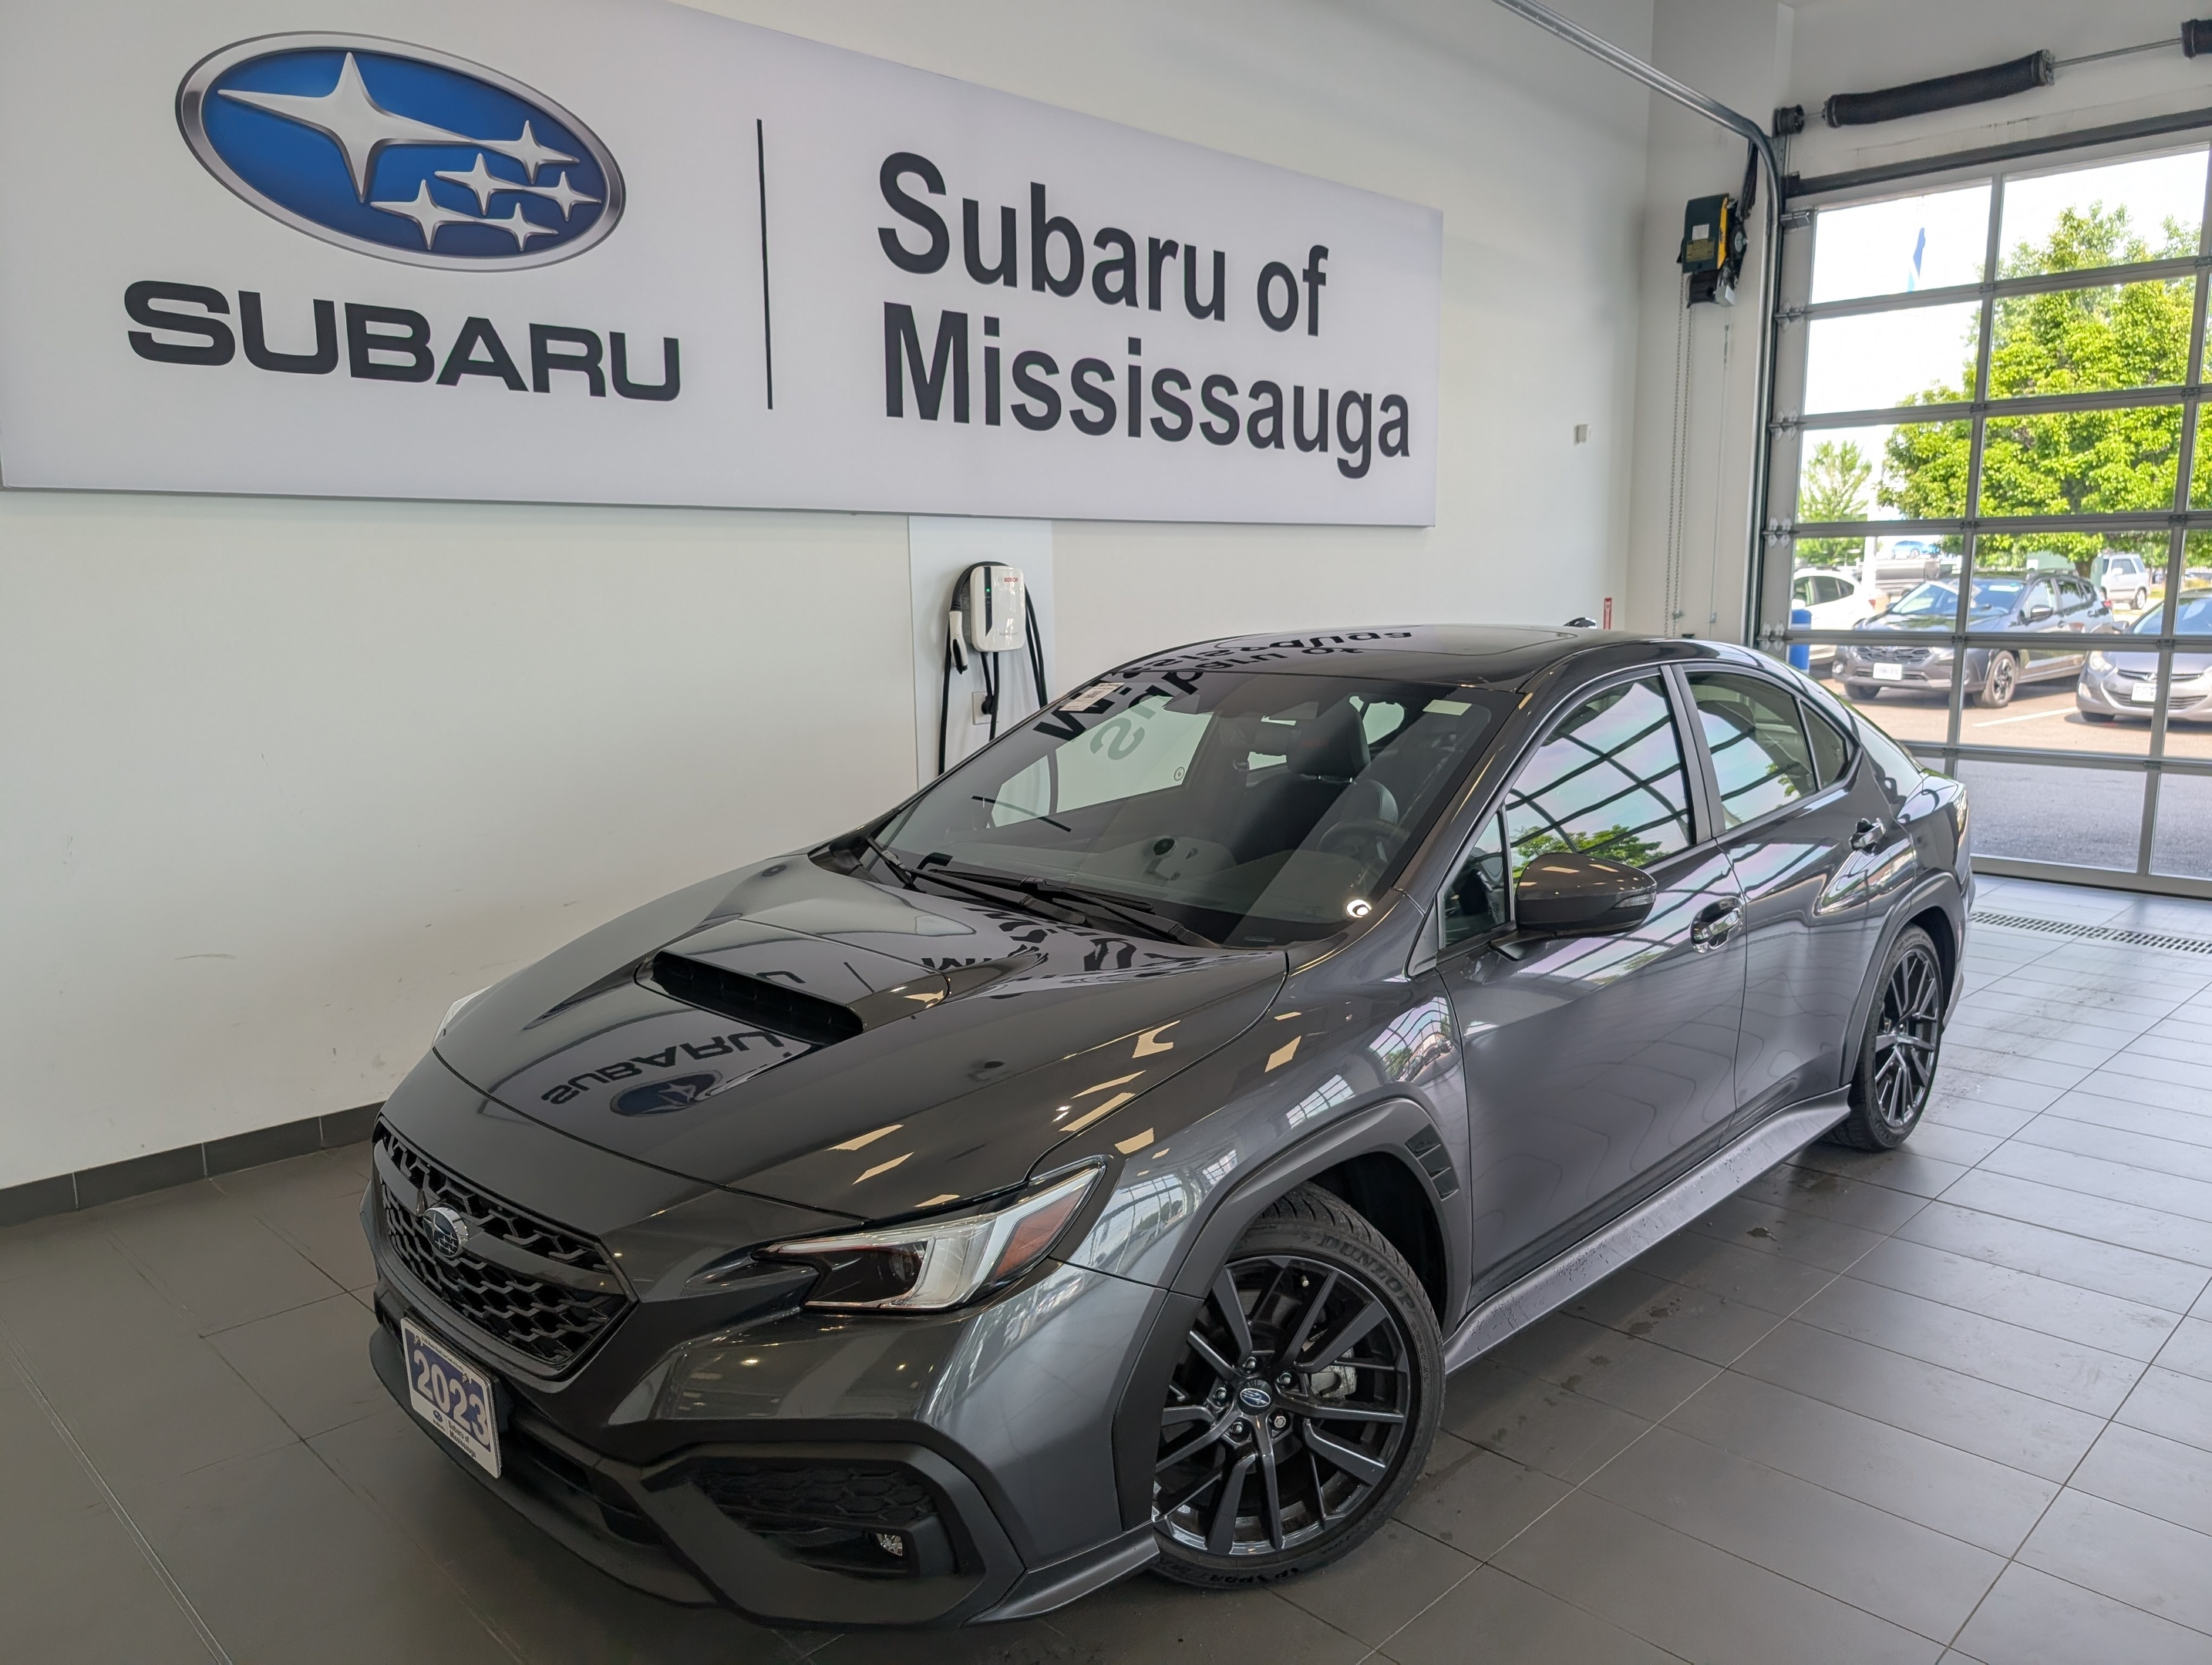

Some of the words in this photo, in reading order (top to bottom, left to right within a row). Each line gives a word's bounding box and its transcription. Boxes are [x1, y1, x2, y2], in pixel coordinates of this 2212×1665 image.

[877, 151, 1226, 322] Subaru
[1257, 244, 1329, 337] of
[124, 280, 681, 402] SUBARU
[884, 301, 1410, 479] Mississauga
[1316, 1234, 1416, 1309] DUNLOP
[415, 1350, 490, 1446] 2023
